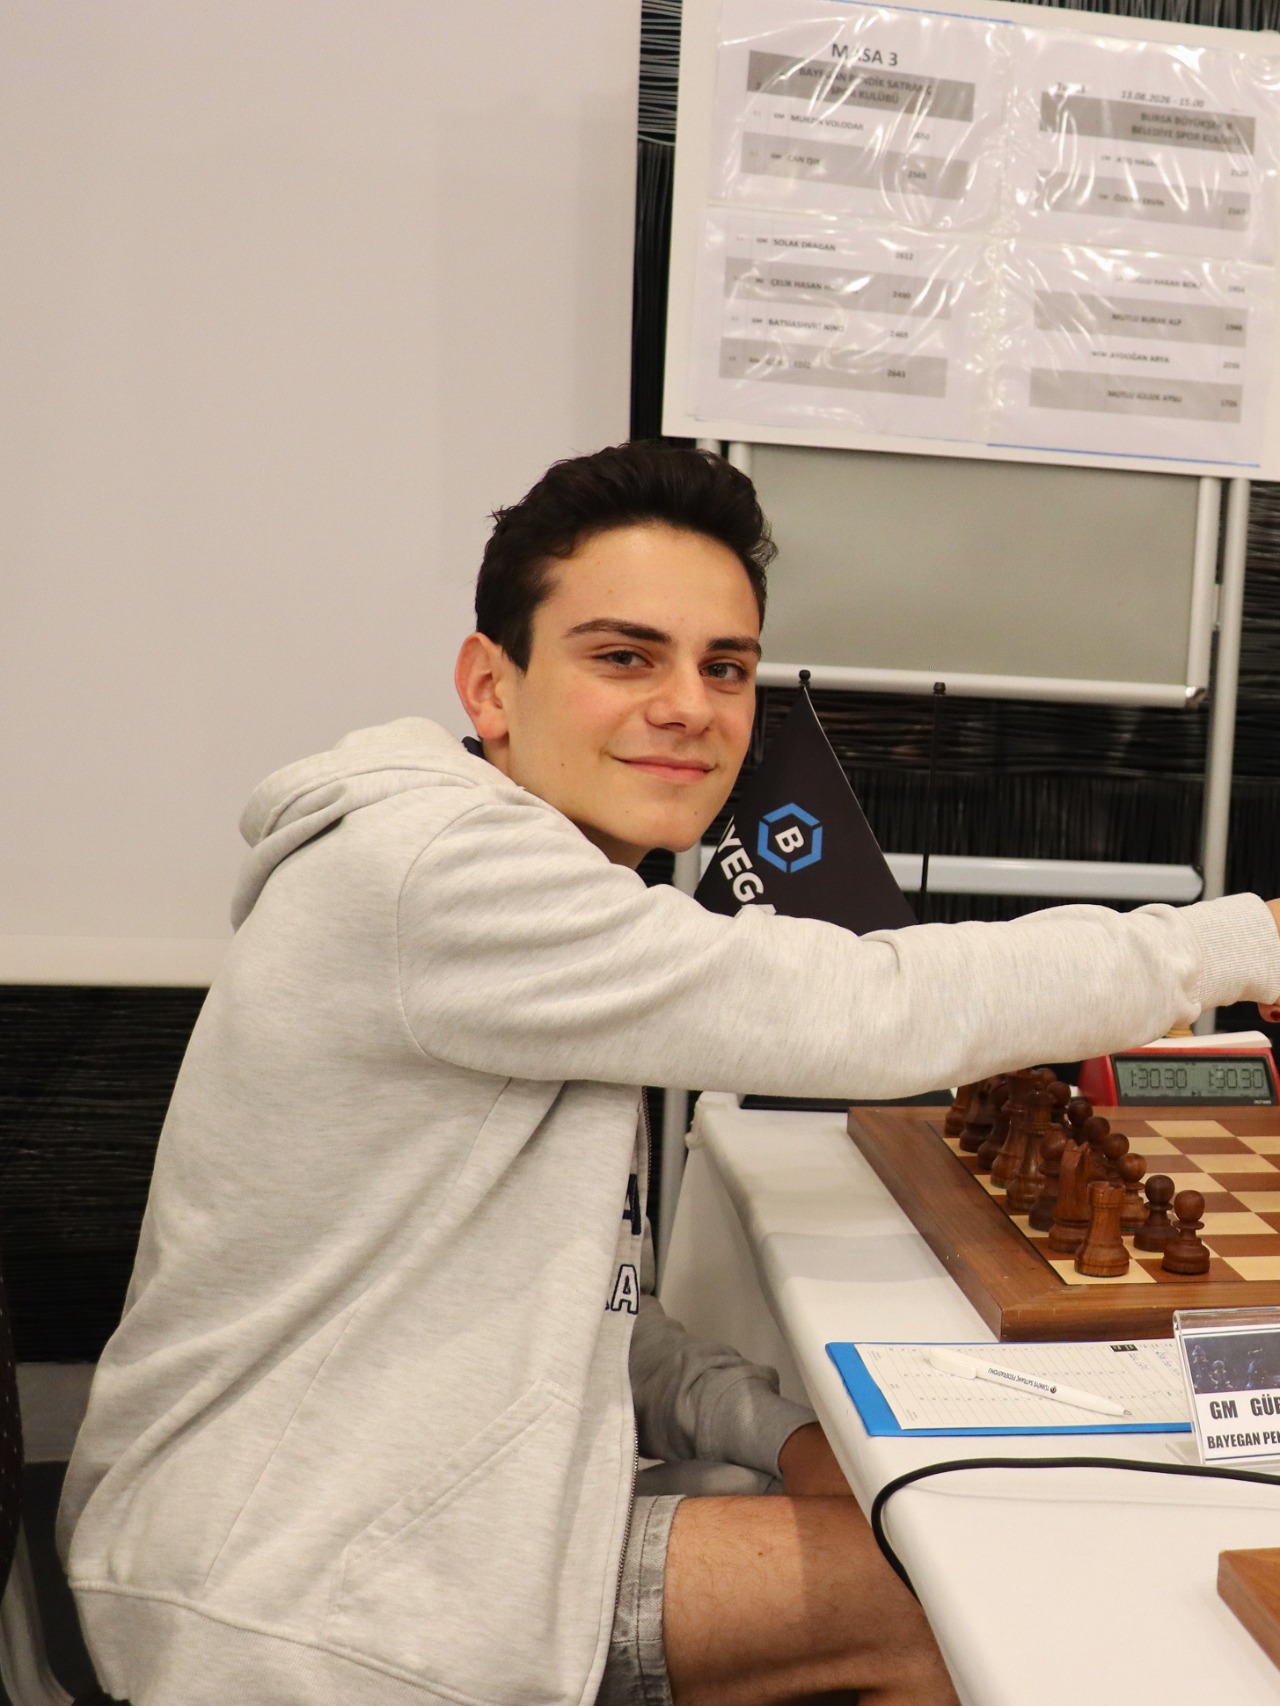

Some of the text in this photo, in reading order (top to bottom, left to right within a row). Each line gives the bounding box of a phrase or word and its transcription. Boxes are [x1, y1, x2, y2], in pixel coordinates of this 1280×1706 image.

[888, 52, 899, 66] 3
[848, 72, 885, 87] PNDİK
[774, 826, 805, 854] B
[1209, 1400, 1239, 1419] GM
[1207, 1432, 1260, 1449] BAYEGAN
